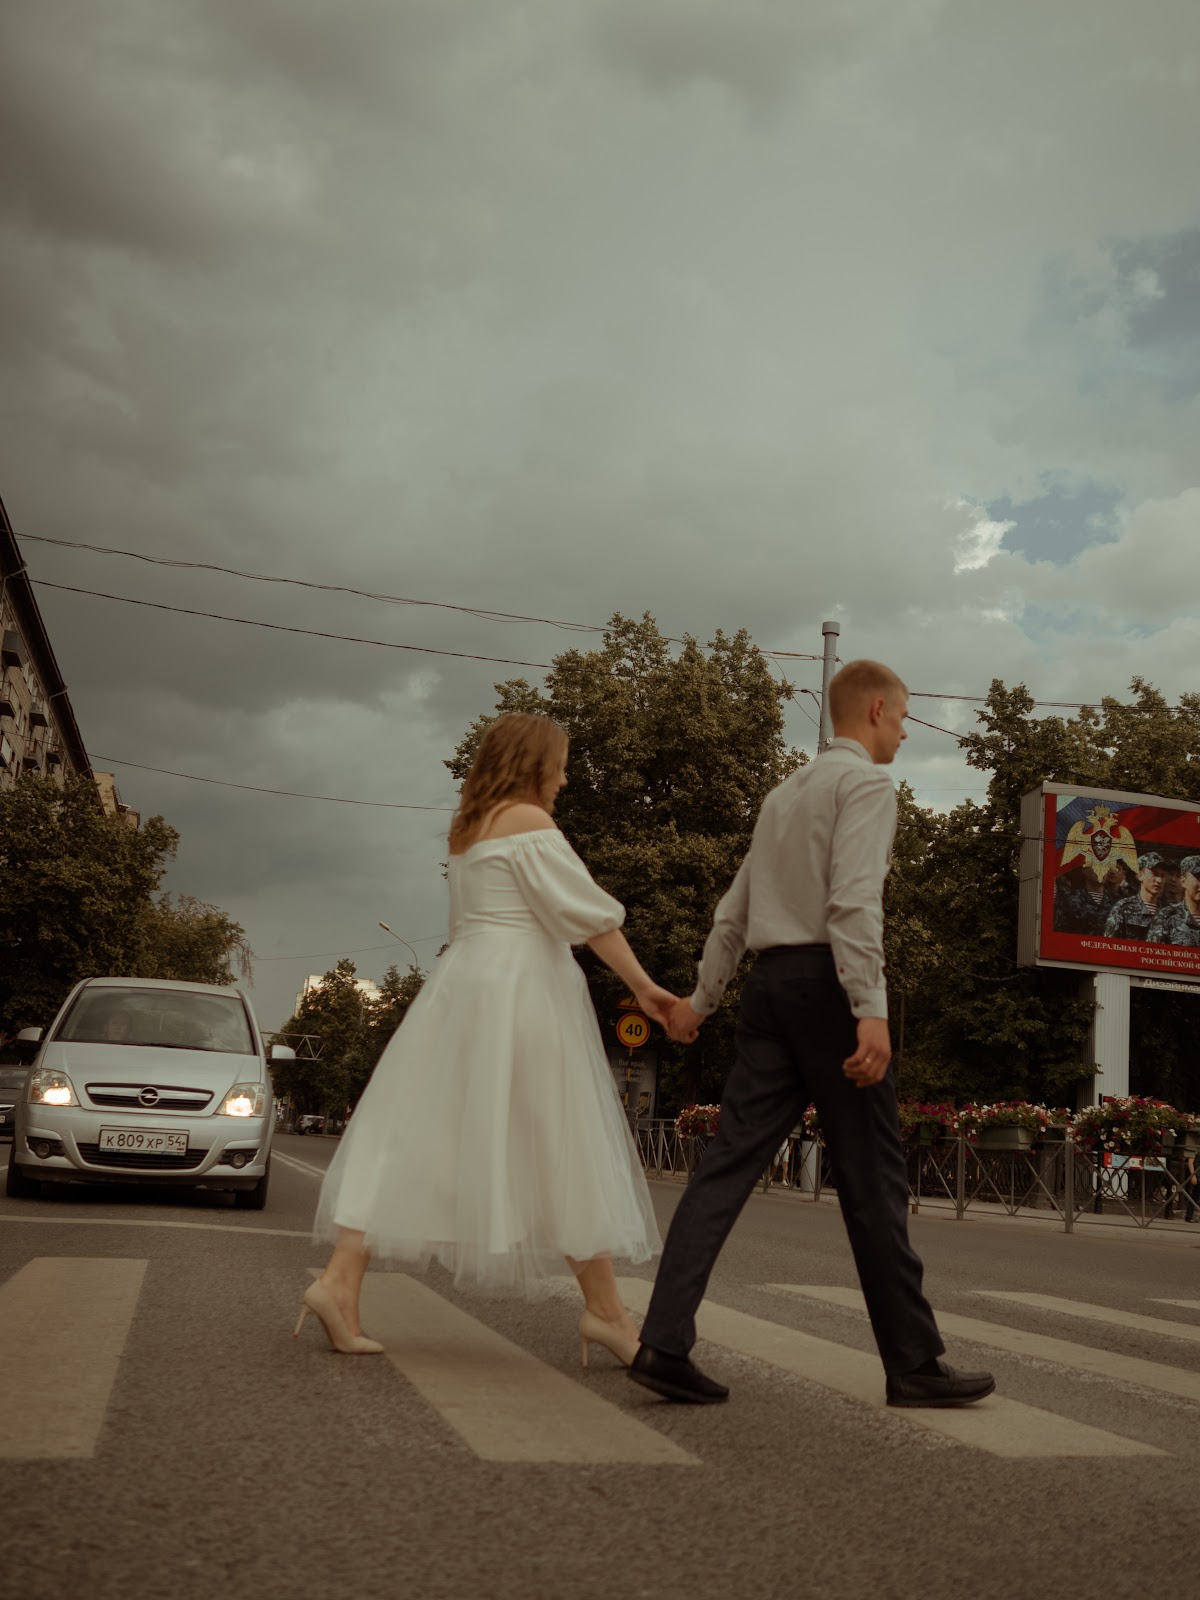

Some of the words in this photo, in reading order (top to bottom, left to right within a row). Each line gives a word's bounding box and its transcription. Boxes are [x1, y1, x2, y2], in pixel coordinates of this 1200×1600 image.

[1080, 940, 1138, 952] ФЕДЕРАЛЬНАЯ
[1138, 946, 1172, 957] СЛУЖБА
[1173, 950, 1200, 960] ВОЙСК
[1141, 957, 1194, 969] РОССИЙСКОЙ
[625, 1023, 642, 1037] 40
